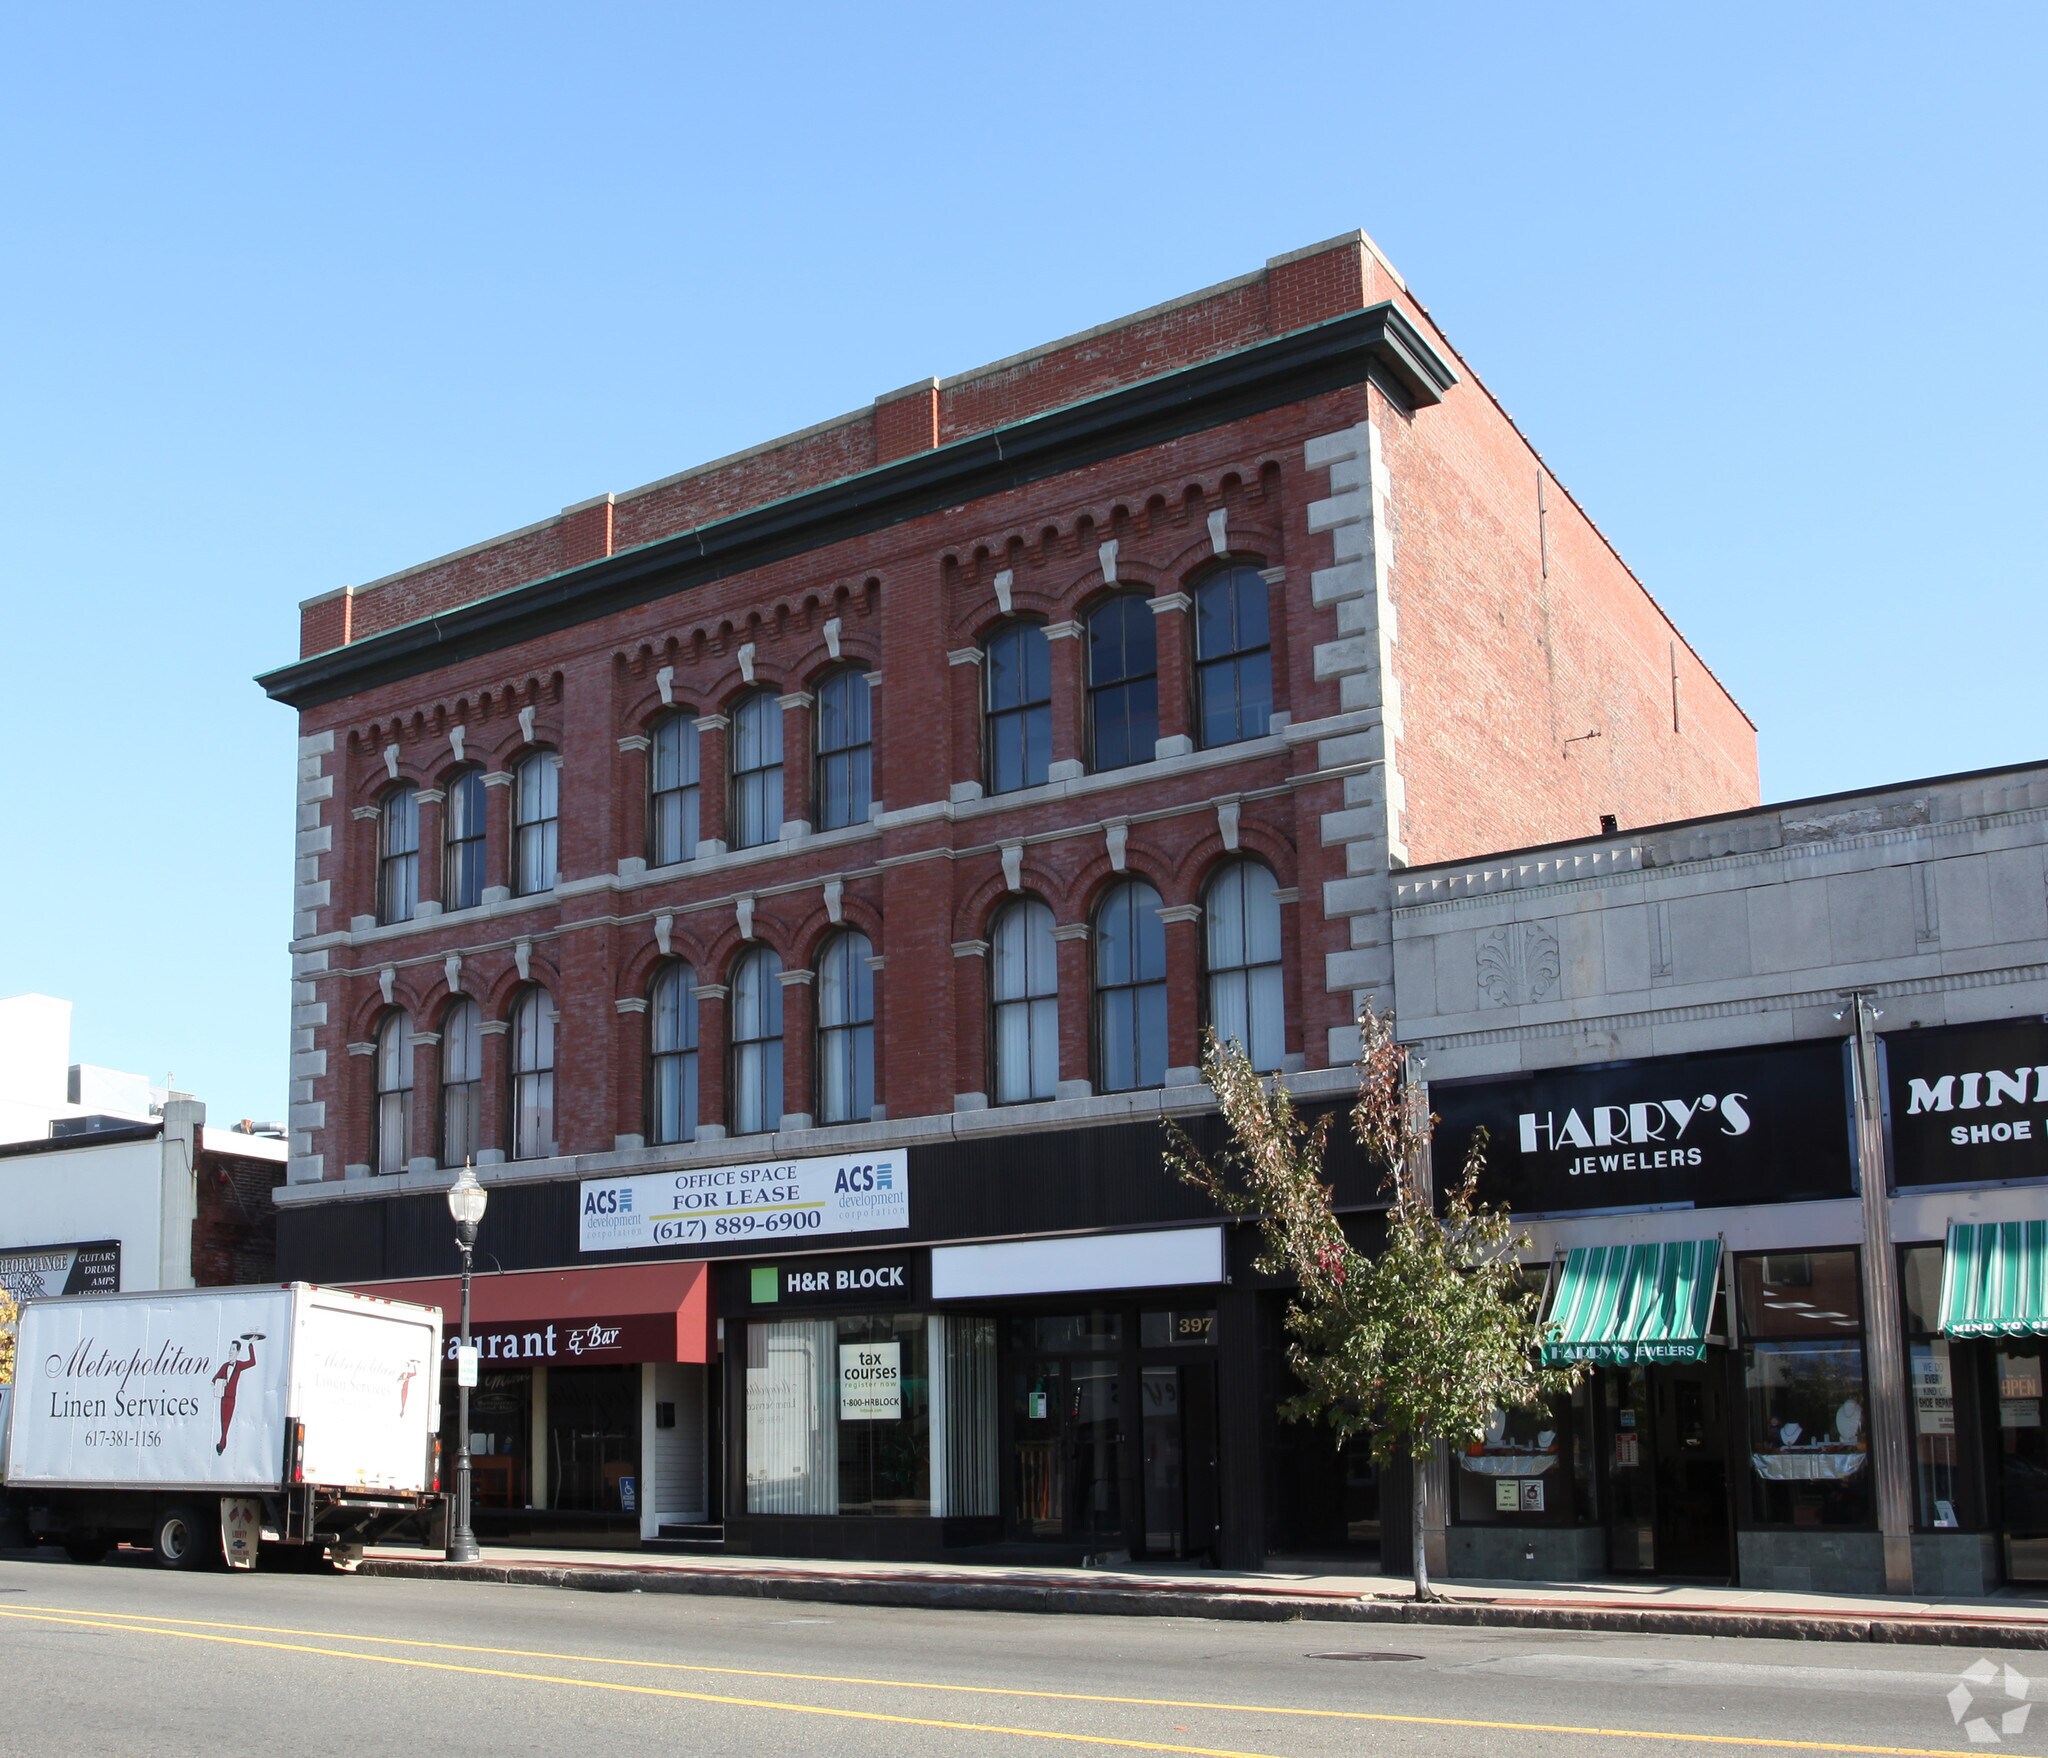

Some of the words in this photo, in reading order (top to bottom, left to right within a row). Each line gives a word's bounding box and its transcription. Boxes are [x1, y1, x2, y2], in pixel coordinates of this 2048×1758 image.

[1519, 1092, 1751, 1154] HARRY'S
[1951, 1120, 2032, 1145] SHOE
[1568, 1146, 1702, 1176] JEWELERS
[675, 1175, 736, 1190] OFFICE
[740, 1166, 797, 1184] SPACE
[834, 1165, 874, 1194] ACS
[584, 1190, 616, 1216] ACS
[673, 1193, 719, 1210] FOR
[726, 1185, 800, 1205] LEASE
[838, 1191, 904, 1210] development
[588, 1213, 641, 1230] development
[839, 1207, 904, 1220] corporation
[653, 1218, 707, 1244] (617)
[715, 1210, 821, 1235] 889-6900
[78, 1252, 116, 1262] GUITARS
[84, 1264, 116, 1274] DRUMS
[91, 1276, 115, 1286] AMPS
[788, 1271, 830, 1292] H&R
[836, 1266, 904, 1290] BLOCK
[1179, 1318, 1214, 1333] 397
[1952, 1323, 1994, 1333] MIND
[441, 1325, 557, 1360] aurant
[587, 1323, 619, 1348] Bar
[859, 1352, 882, 1366] tax
[1551, 1346, 1630, 1360] HARRY'S
[1634, 1346, 1695, 1358] JEWELERS
[45, 1337, 211, 1390] Metropolitan
[844, 1367, 896, 1380] courses
[2001, 1378, 2036, 1396] OPEN
[50, 1392, 106, 1418] Linen
[114, 1390, 199, 1417] Services
[842, 1398, 900, 1406] 1-800-HRBLOCK
[85, 1430, 162, 1447] 617-381-1156
